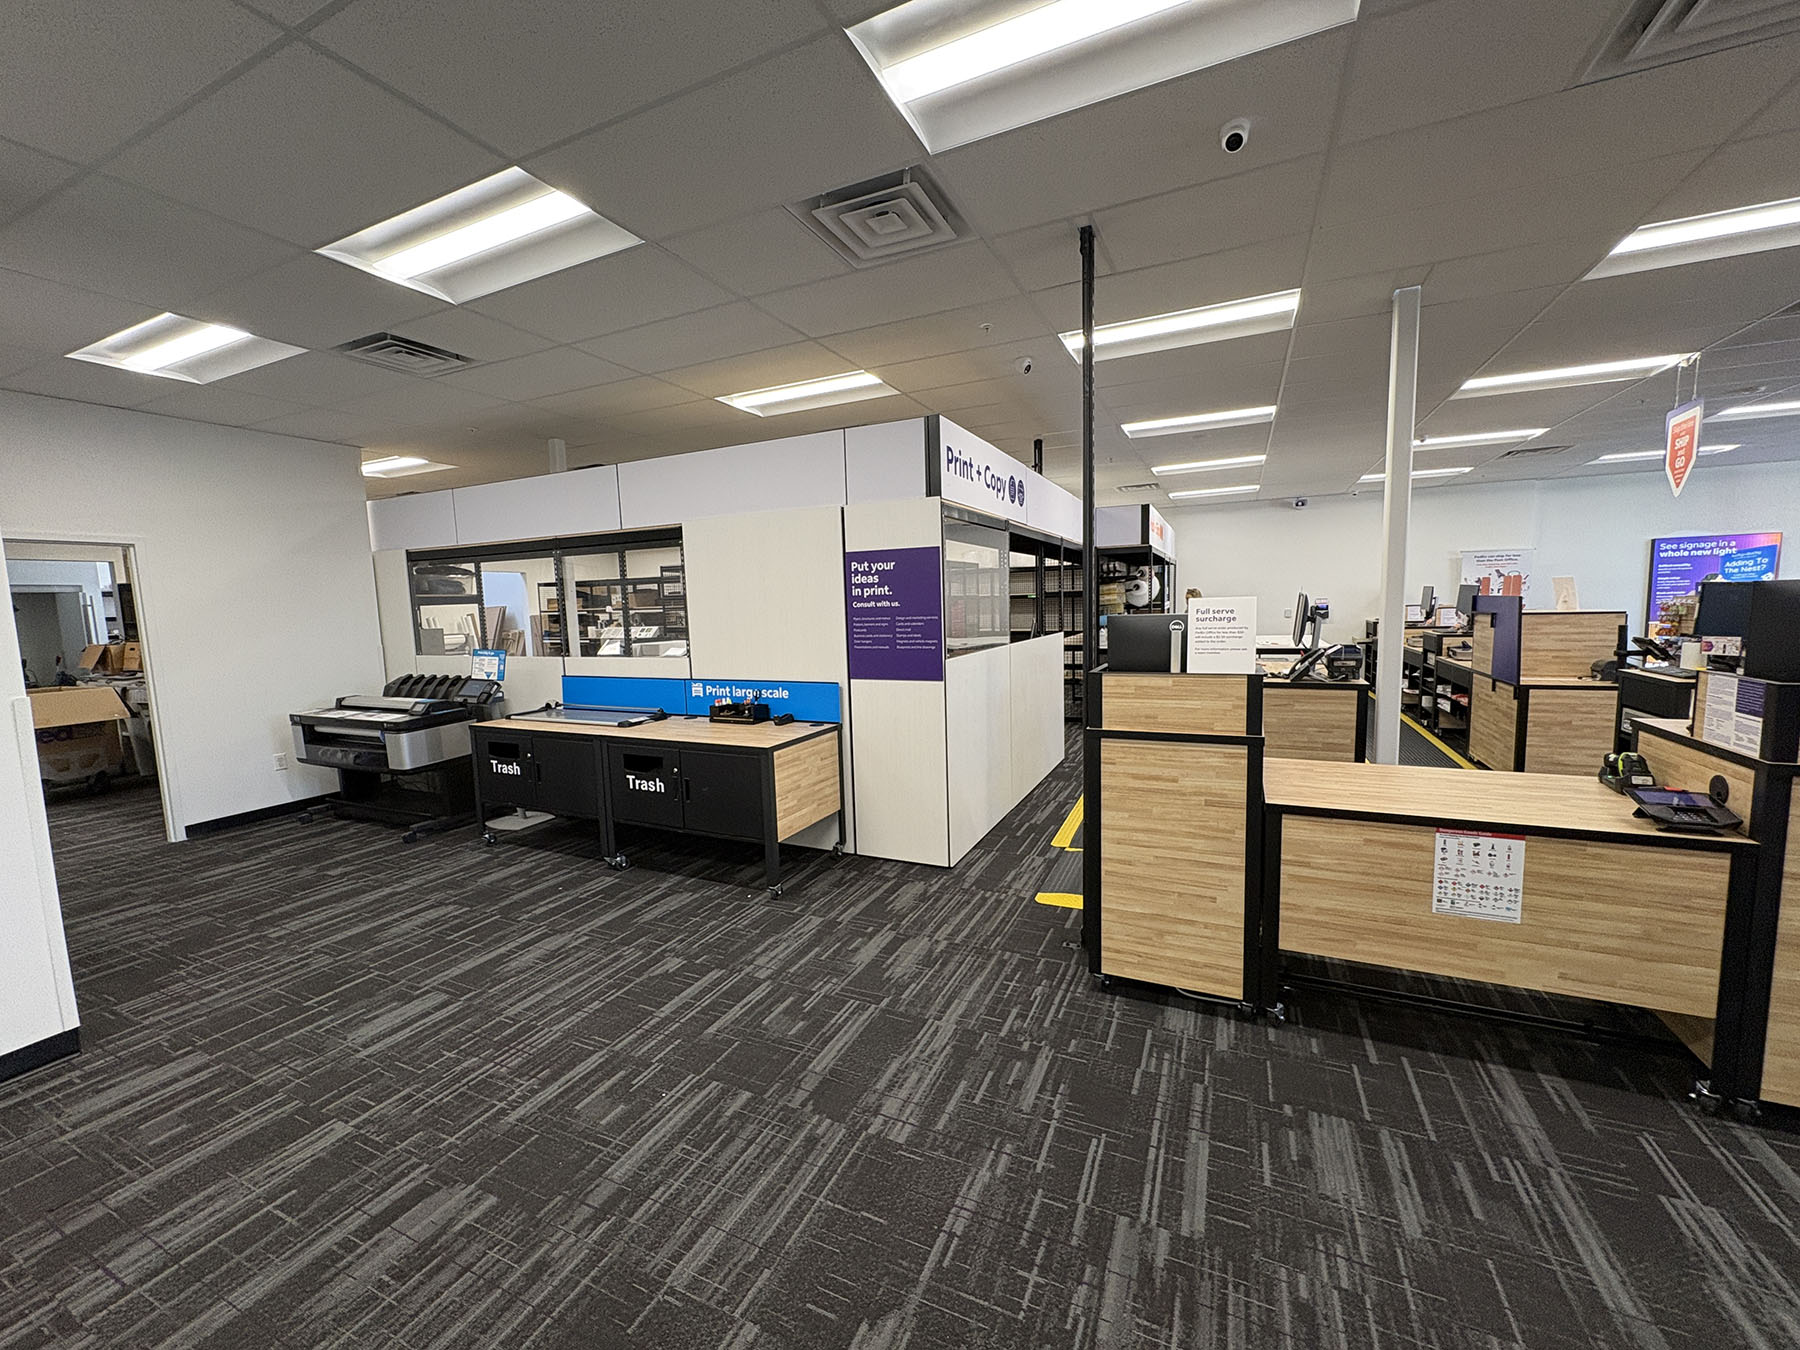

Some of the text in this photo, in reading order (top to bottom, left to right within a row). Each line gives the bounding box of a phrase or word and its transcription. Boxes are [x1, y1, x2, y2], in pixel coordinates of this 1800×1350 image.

[946, 445, 1006, 501] Print + Copy
[1660, 542, 1678, 550] See
[1679, 540, 1716, 551] signage
[1719, 540, 1728, 548] in
[1714, 548, 1737, 556] light
[852, 562, 896, 573] Put your
[1724, 558, 1753, 569] Adding
[1741, 564, 1766, 572] Nest?
[852, 574, 879, 584] ideas
[852, 586, 892, 598] in print.
[706, 686, 730, 698] Print
[761, 688, 789, 699] scale
[490, 760, 520, 776] Trash
[626, 774, 664, 793] Trash
